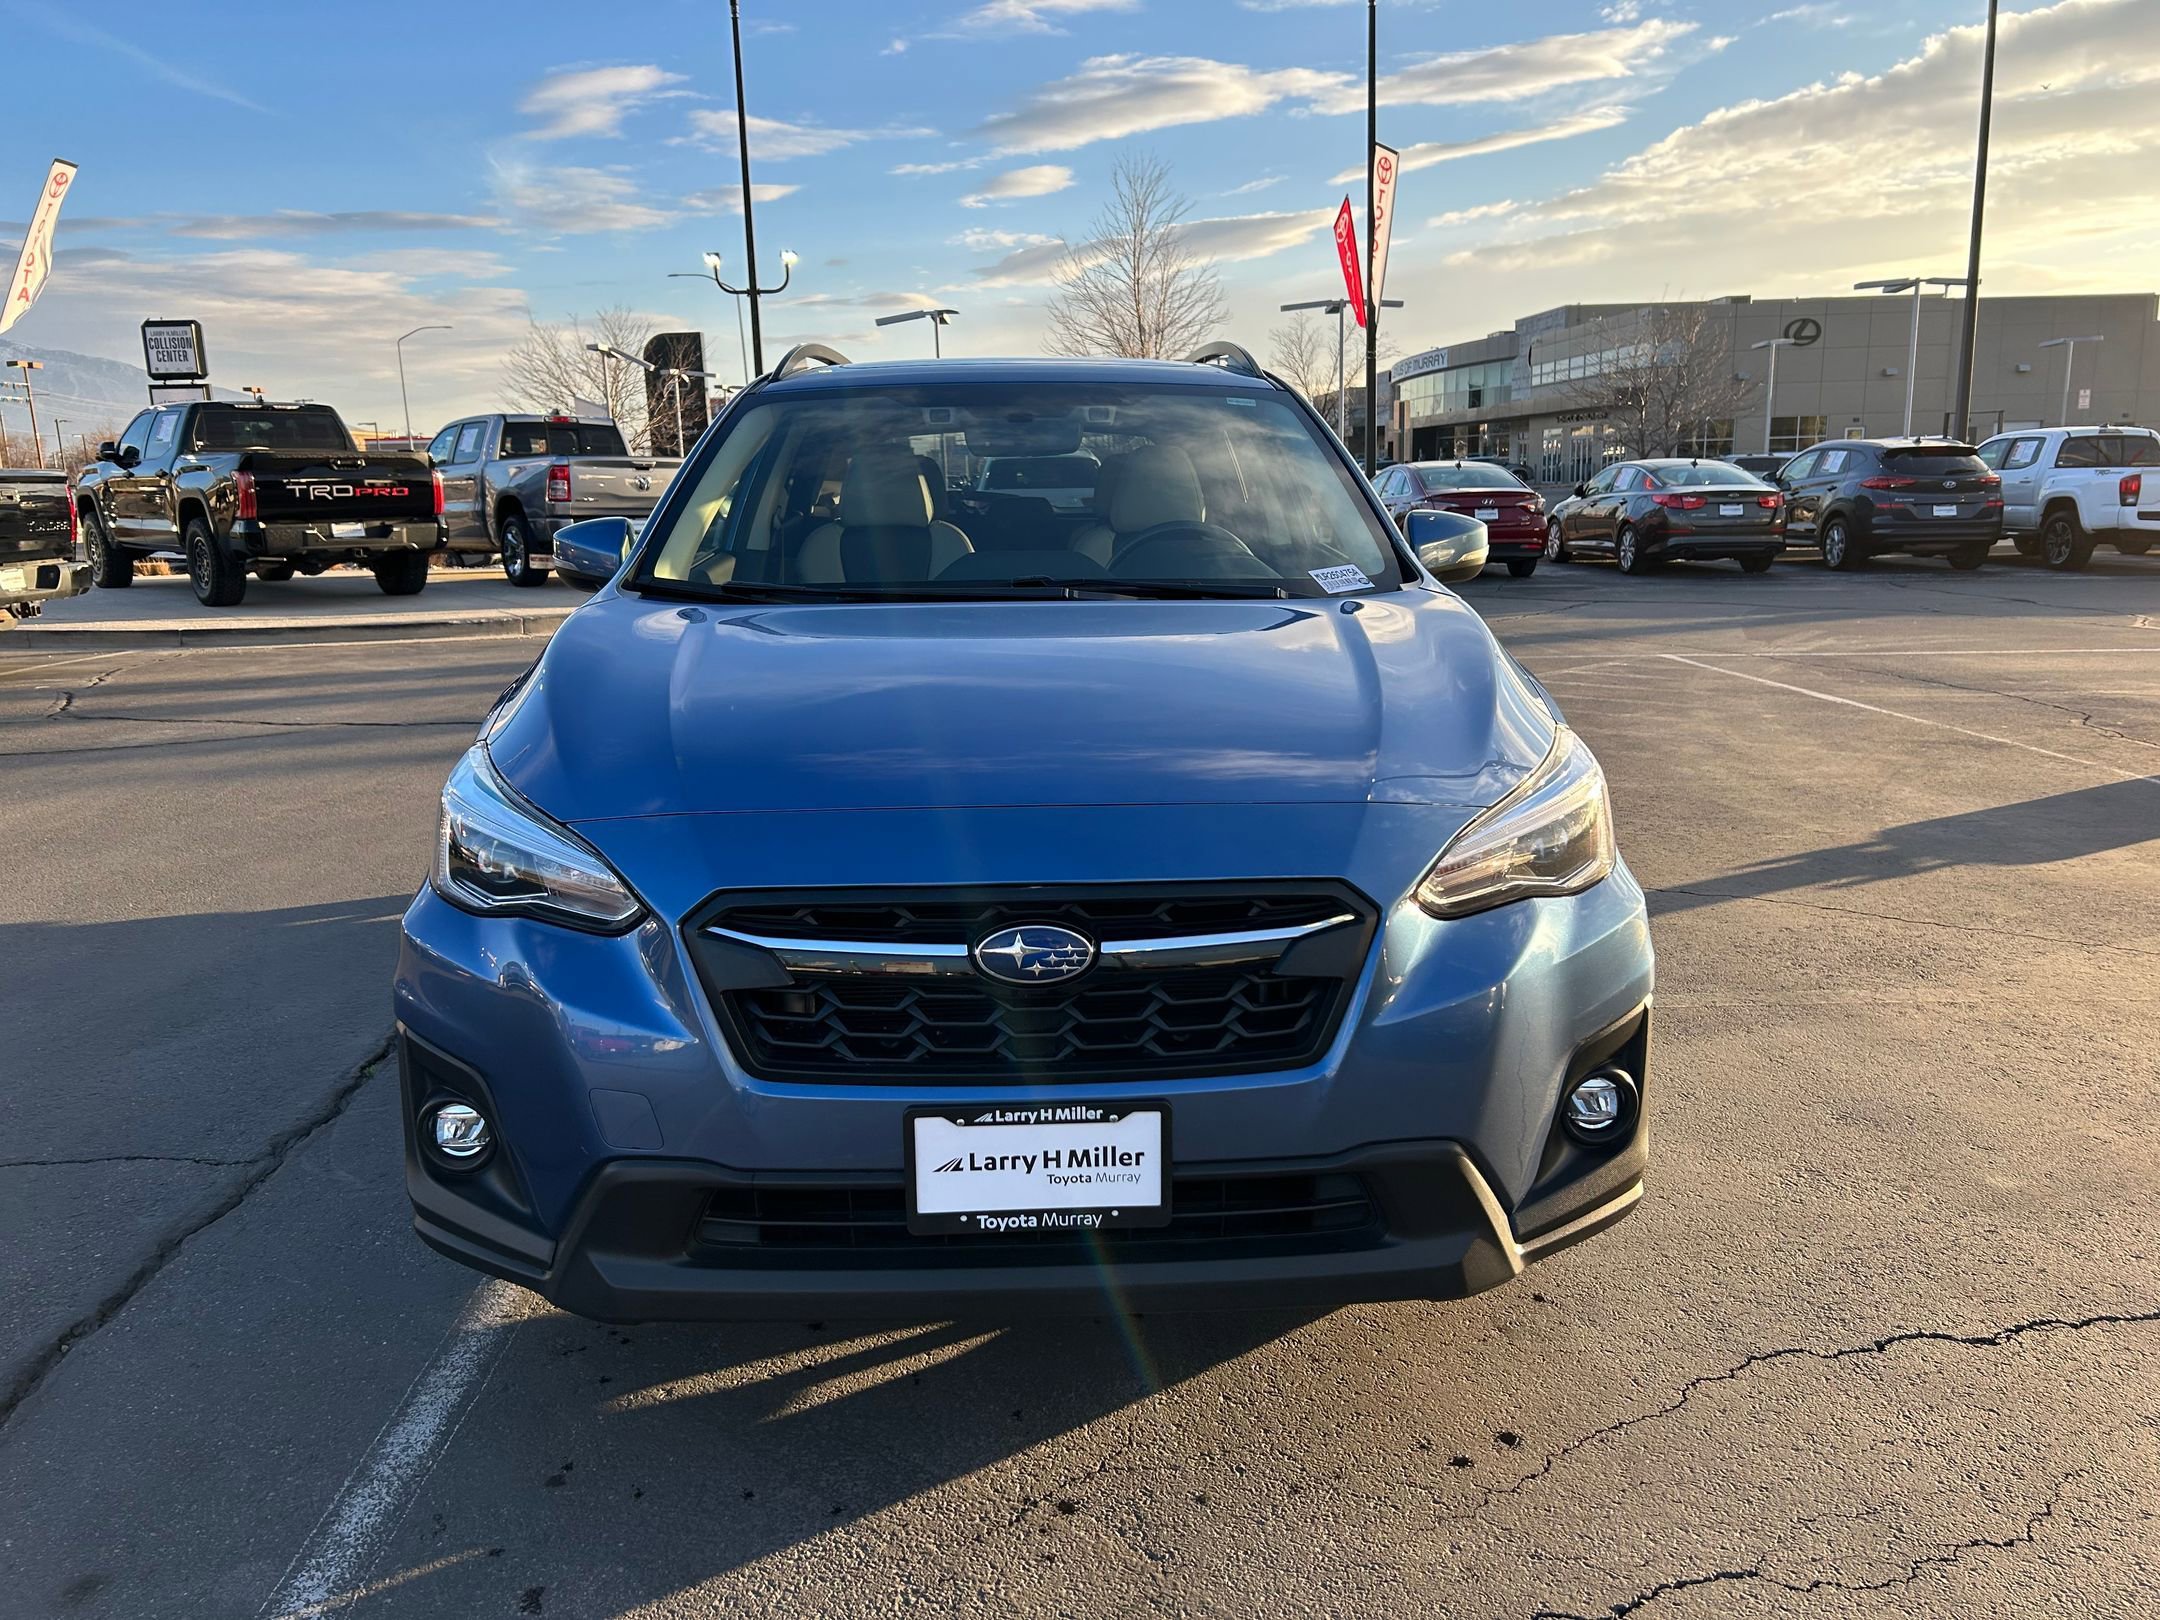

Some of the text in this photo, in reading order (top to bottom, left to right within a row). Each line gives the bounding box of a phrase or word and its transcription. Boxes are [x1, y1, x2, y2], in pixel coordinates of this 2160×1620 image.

[17, 203, 53, 302] TOYOTA
[148, 337, 193, 350] COLLISION
[156, 350, 189, 362] CENTER
[1413, 353, 1447, 370] MURRAY
[286, 485, 409, 500] TRD PRO
[995, 1106, 1104, 1124] Larry H Miller
[969, 1146, 1145, 1175] Larry H Miller
[1046, 1172, 1141, 1186] Toyota Murray
[976, 1212, 1103, 1232] Toyota Murray
